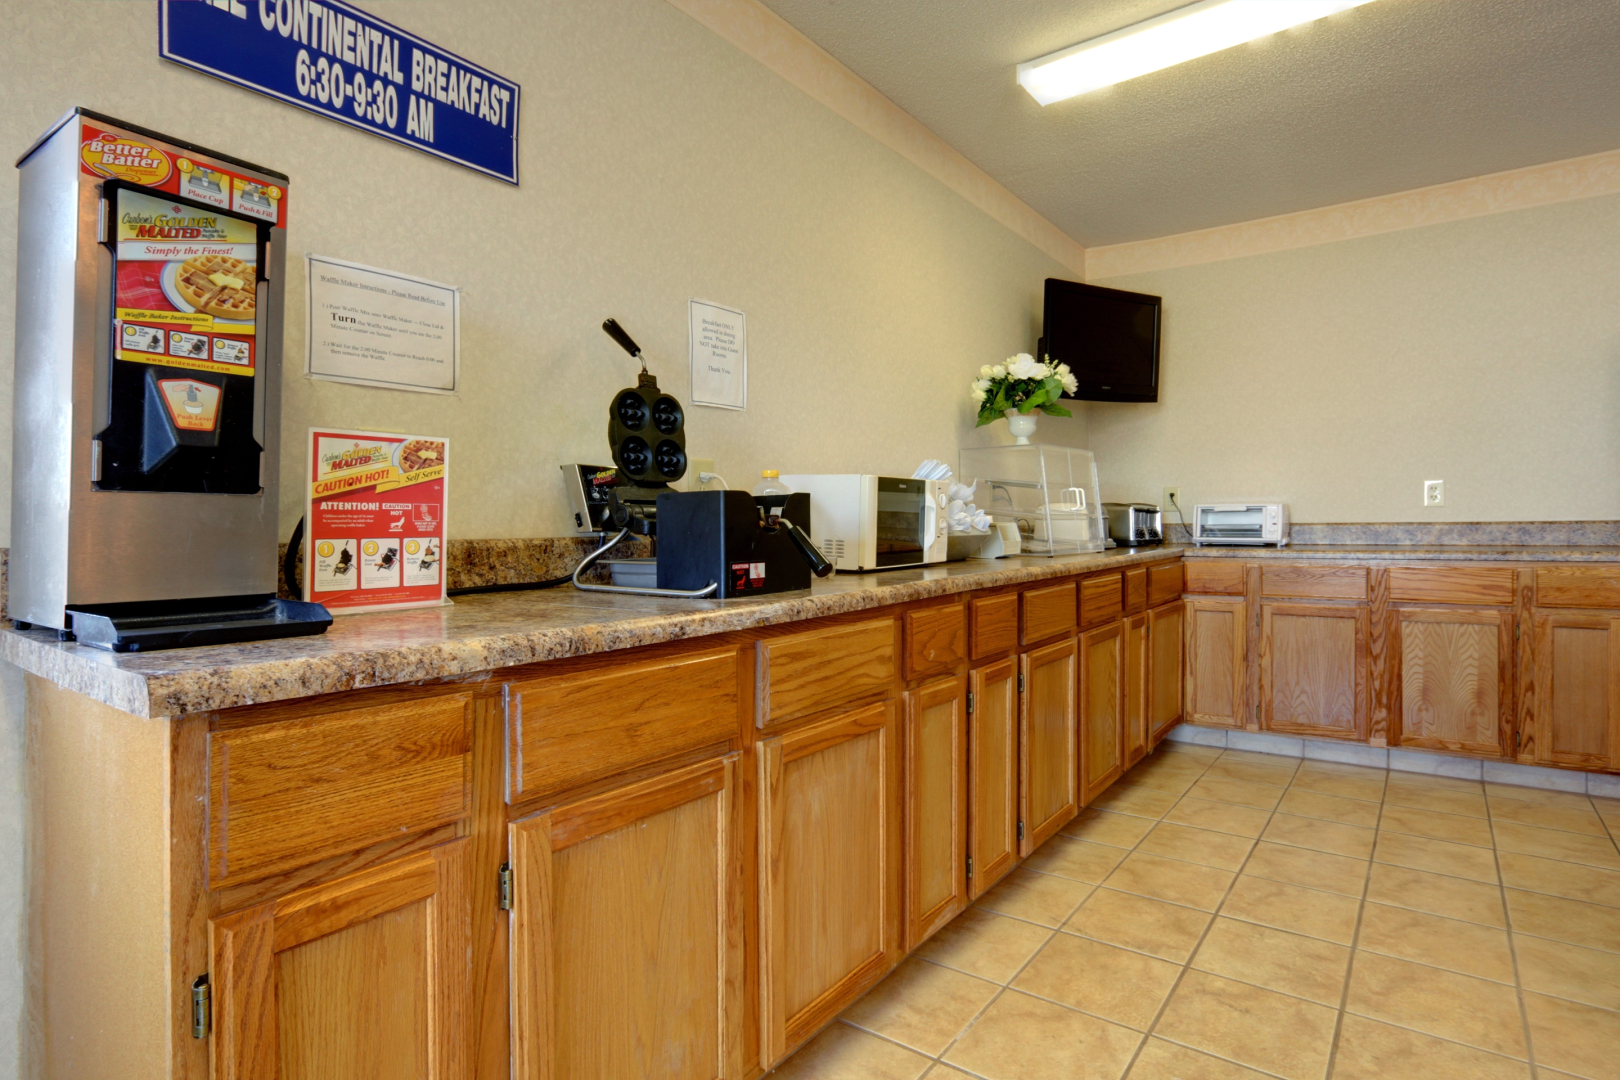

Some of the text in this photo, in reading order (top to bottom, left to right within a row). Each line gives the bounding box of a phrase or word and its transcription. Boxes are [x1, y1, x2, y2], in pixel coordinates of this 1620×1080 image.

[259, 0, 510, 128] CONTINENTAL BREAKFAST
[295, 48, 434, 143] 6:30-9:30 AM
[89, 141, 152, 156] Better
[101, 153, 161, 168] Batter
[125, 167, 157, 175] Dispenser
[188, 189, 224, 205] Place Cup
[239, 204, 256, 213] Push
[262, 209, 274, 218] Fill
[154, 214, 218, 229] GOLDEN
[136, 224, 202, 239] MALTED
[144, 245, 234, 256] Simply the Finest!
[320, 274, 339, 284] Waffle
[341, 279, 358, 288] Maker
[407, 293, 419, 301] Read
[420, 296, 436, 304] Before
[124, 311, 209, 323] Waffle Baker Instructions
[342, 305, 359, 313] Waffle
[360, 308, 370, 316] Mix
[383, 313, 398, 321] Waffle
[399, 316, 412, 324] Maker
[330, 312, 356, 324] Turn
[366, 321, 382, 330] Waffle
[383, 324, 398, 332] Maker
[330, 323, 348, 331] Minute
[349, 326, 368, 335] Counter
[702, 318, 734, 331] Breakfast ONLY
[702, 327, 719, 335] allowed
[699, 340, 710, 348] NOT
[710, 342, 720, 350] take
[715, 336, 727, 345] Please
[342, 350, 360, 358] remove
[371, 347, 388, 356] Minute
[145, 356, 231, 372] www.goldenmalted.com
[708, 365, 721, 374] Thank
[341, 446, 382, 460] GOLDEN
[330, 455, 372, 471] MALTED
[314, 469, 390, 494] CAUTION HOT!
[405, 468, 442, 483] Self Serve
[320, 501, 379, 510] ATTENTION!
[323, 545, 328, 554] 1
[368, 544, 374, 553] 2
[410, 543, 416, 551] 3
